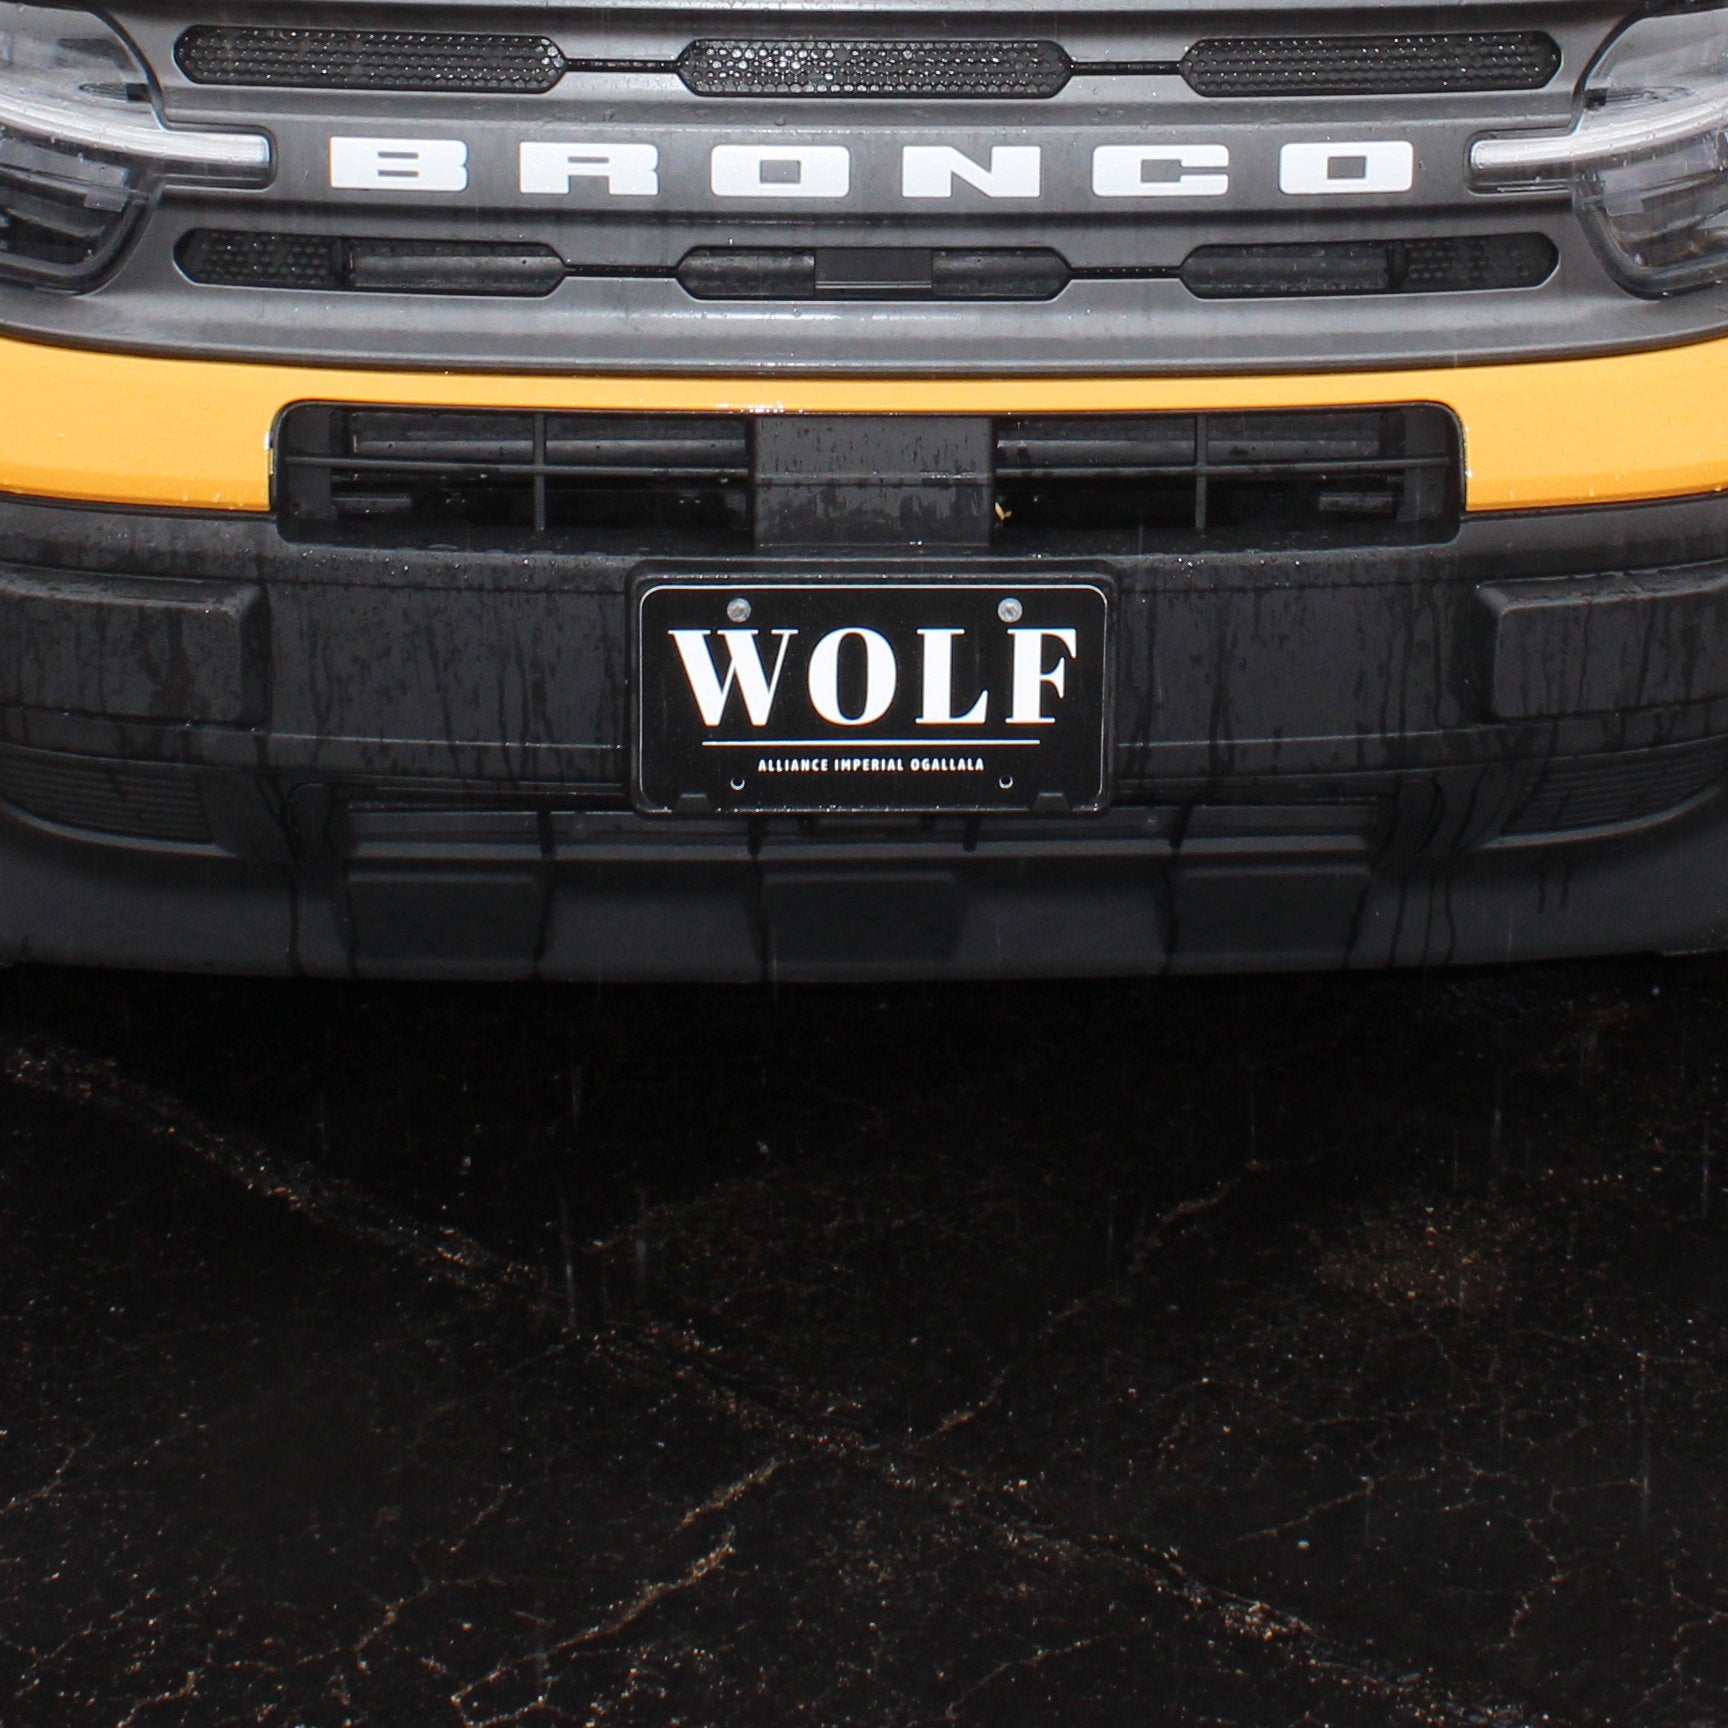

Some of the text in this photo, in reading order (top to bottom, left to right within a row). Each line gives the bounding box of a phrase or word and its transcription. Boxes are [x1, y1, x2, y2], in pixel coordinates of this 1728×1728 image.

[329, 136, 1414, 198] BRONCO
[668, 628, 1078, 727] WOLF
[758, 757, 985, 773] ALLIANCE IMPERIAL OGALLALA
